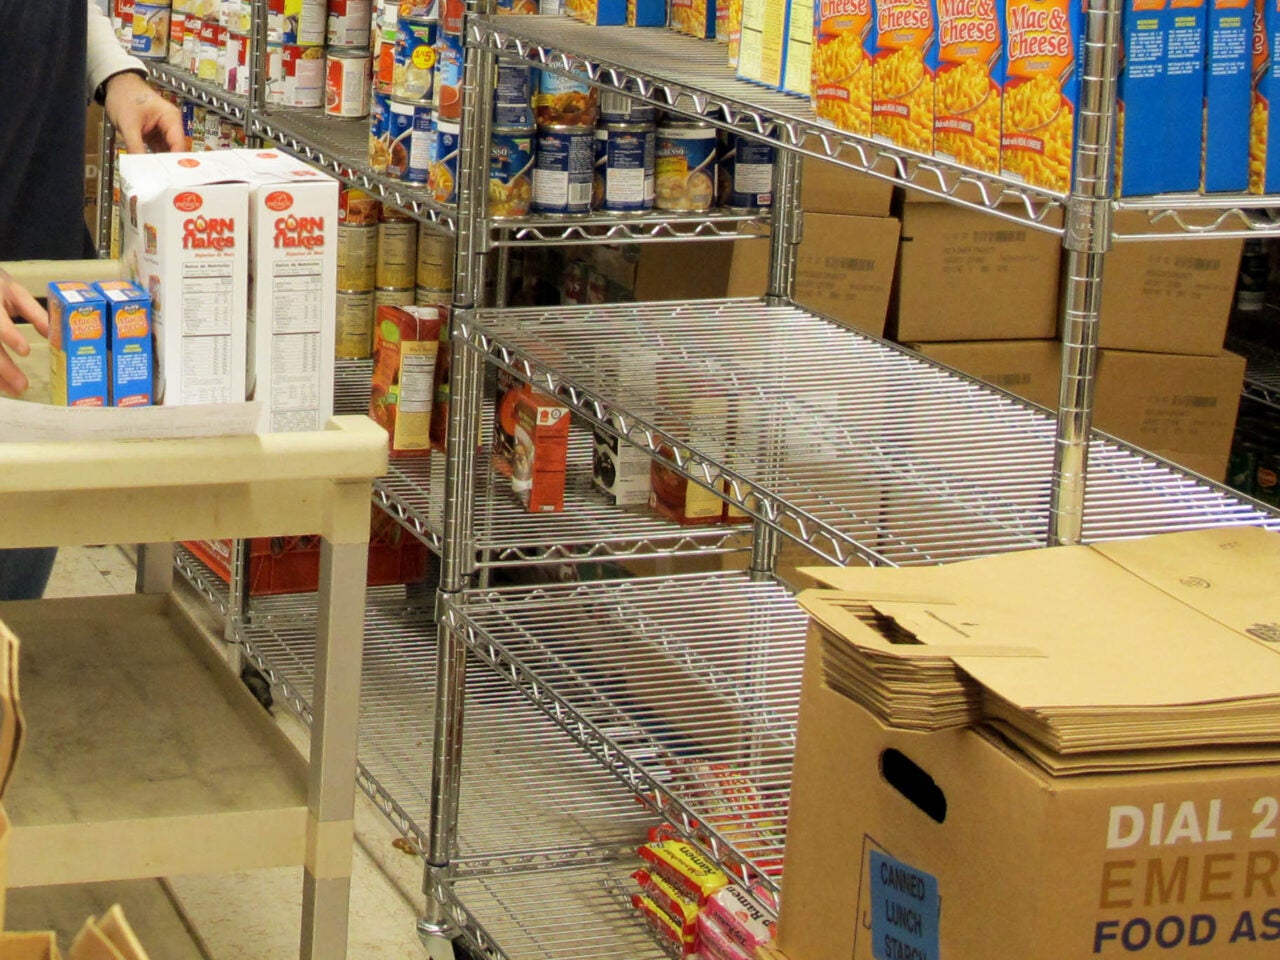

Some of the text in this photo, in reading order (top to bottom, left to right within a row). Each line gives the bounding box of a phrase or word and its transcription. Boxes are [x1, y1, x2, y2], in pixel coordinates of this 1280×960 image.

[878, 7, 929, 34] Cheese
[1010, 5, 1067, 32] Mac &
[939, 20, 997, 48] Cheese
[1008, 33, 1070, 61] Cheese
[183, 214, 234, 234] CORN
[274, 213, 324, 234] CORN
[182, 230, 235, 250] flakes
[273, 230, 325, 250] flakes
[1106, 799, 1232, 850] DIAL
[880, 860, 926, 902] CANNED
[885, 899, 924, 939] LUNCH
[1092, 913, 1217, 955] FOOD
